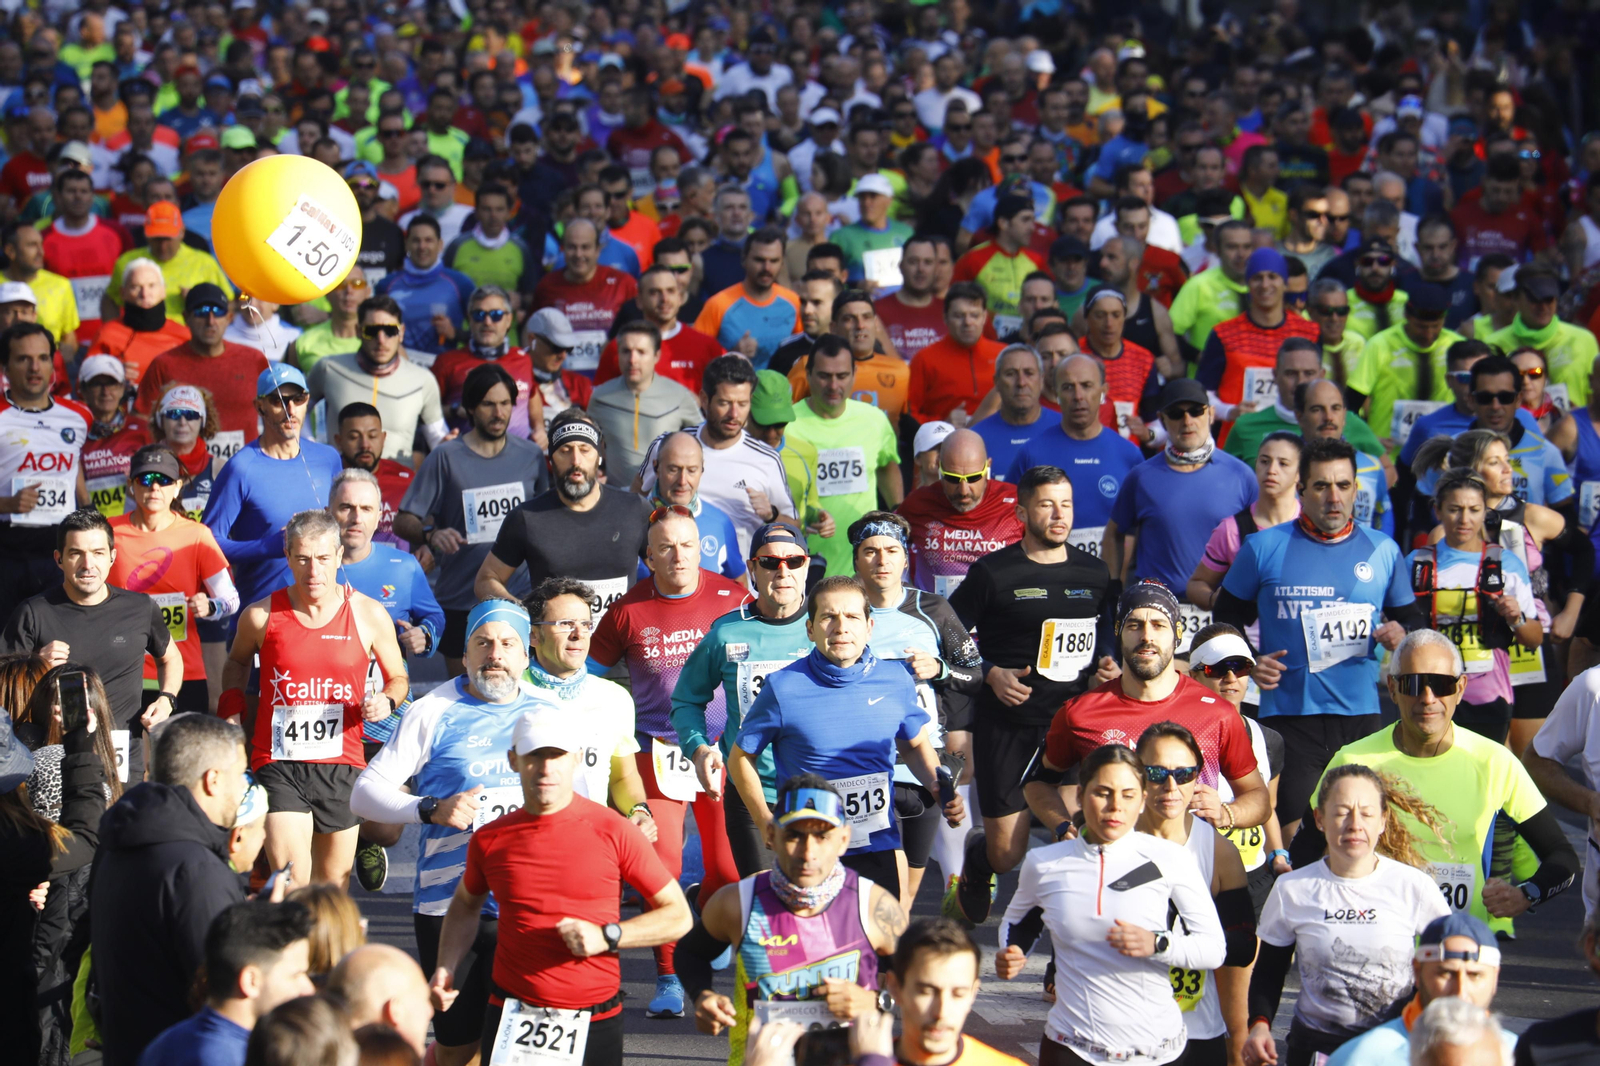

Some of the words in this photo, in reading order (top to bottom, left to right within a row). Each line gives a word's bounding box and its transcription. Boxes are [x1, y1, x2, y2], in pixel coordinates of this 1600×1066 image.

[286, 225, 339, 277] 1:50
[17, 452, 74, 472] AON
[84, 449, 113, 461] MEDIA
[817, 460, 862, 480] 3675
[91, 485, 126, 507] 404
[477, 496, 521, 518] 4090
[925, 538, 939, 550] 36
[944, 537, 1006, 552] MARATÓN
[944, 530, 983, 540] MEDIA
[1274, 586, 1335, 597] ATLETISMO
[161, 606, 184, 626] 95
[1324, 609, 1351, 617] IMDECO
[663, 628, 704, 644] MEDIA
[1320, 619, 1367, 643] 4192
[643, 645, 660, 659] 36
[1055, 632, 1094, 653] 1880
[286, 678, 352, 700] califas
[752, 675, 765, 697] 3
[285, 718, 339, 742] 4197
[836, 779, 866, 788] IMDECO
[846, 788, 886, 816] 513
[1440, 882, 1468, 910] 30
[1324, 908, 1377, 920] LOBXS
[1171, 967, 1201, 995] 33
[500, 1022, 512, 1050] CAJÓN
[515, 1020, 577, 1054] 2521
